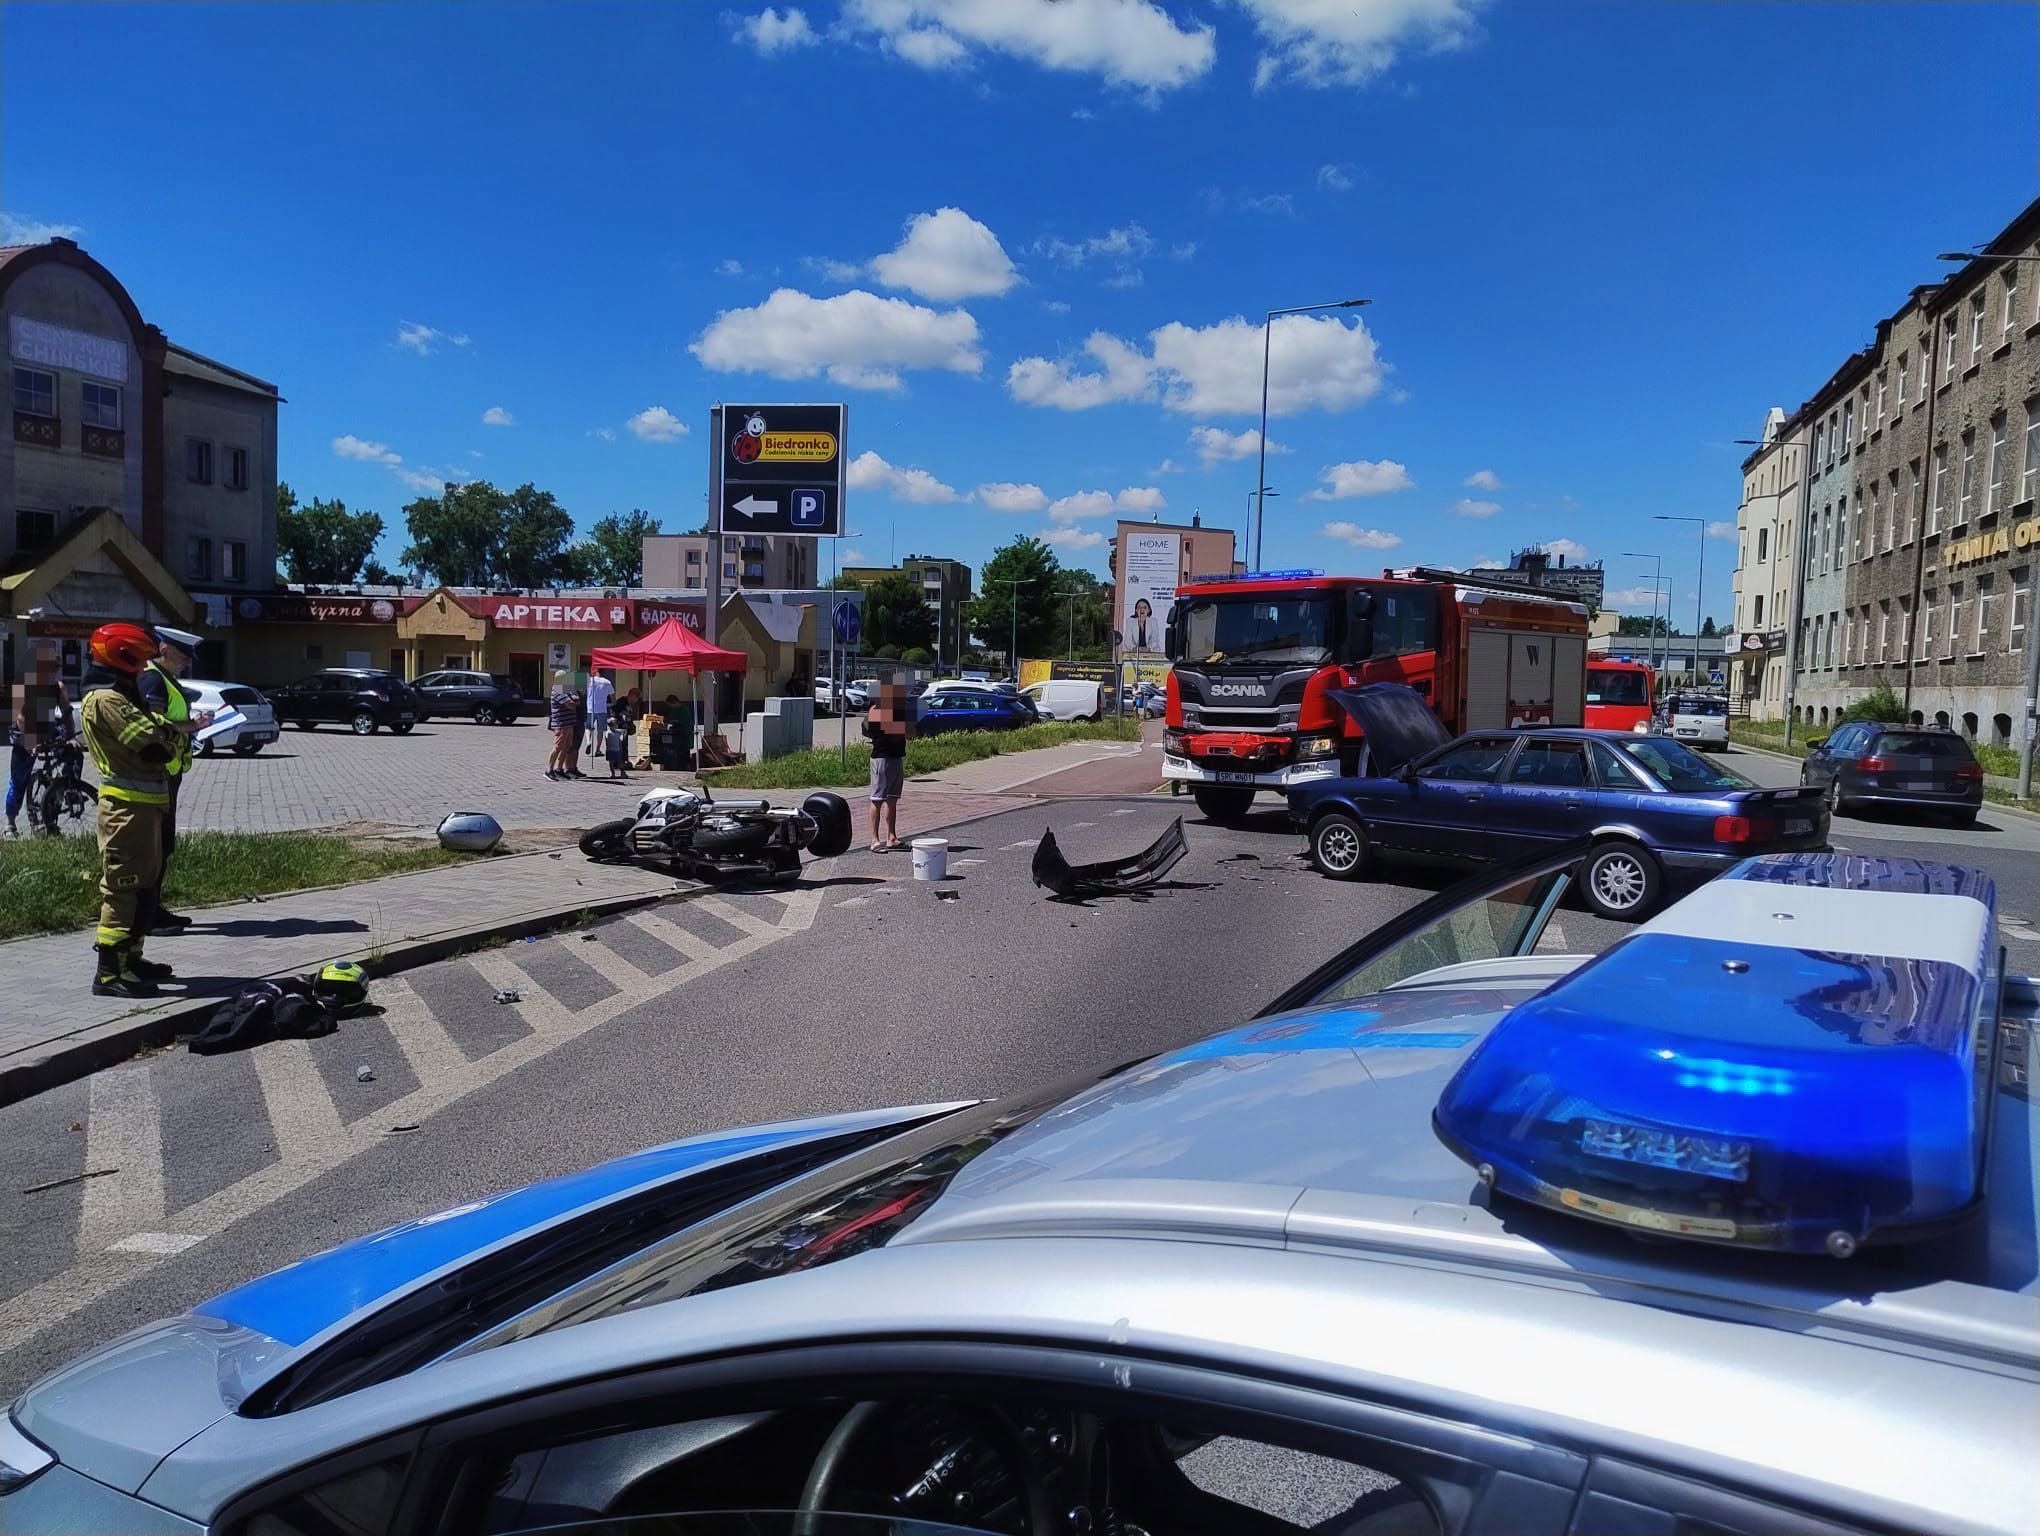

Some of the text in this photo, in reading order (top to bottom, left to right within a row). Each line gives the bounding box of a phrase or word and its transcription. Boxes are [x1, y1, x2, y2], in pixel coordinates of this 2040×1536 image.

[765, 438, 830, 450] Biedronka
[800, 496, 817, 519] P
[1139, 540, 1169, 549] HOME
[1944, 526, 2010, 567] TANIA
[494, 604, 601, 623] APTEKA
[1210, 684, 1267, 697] SCANIA
